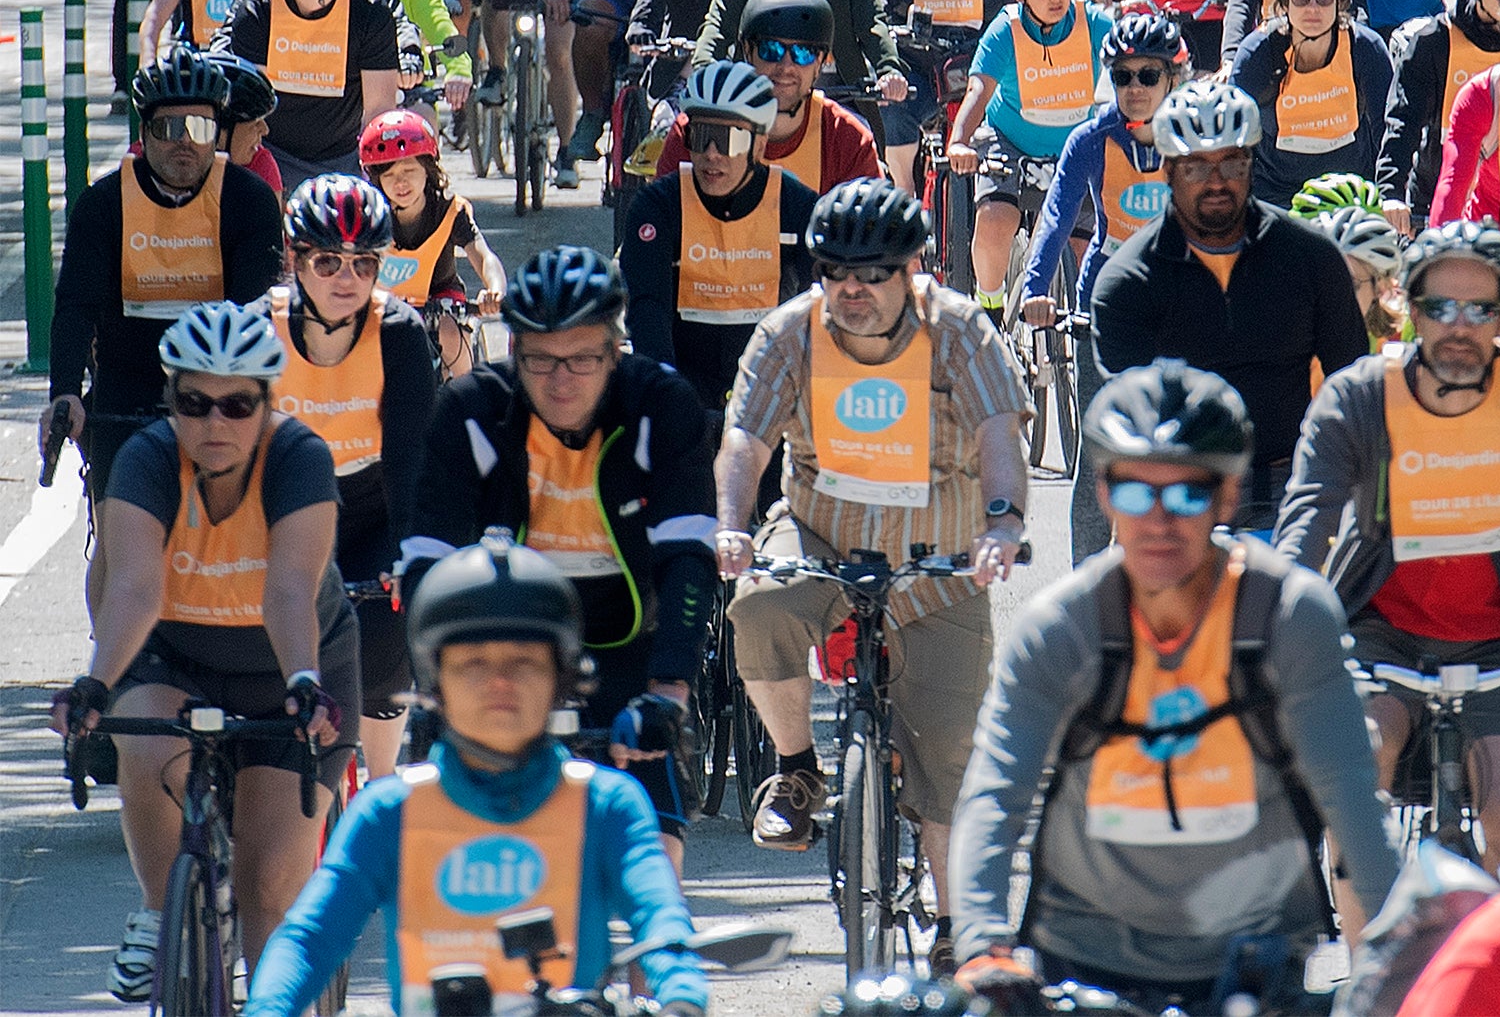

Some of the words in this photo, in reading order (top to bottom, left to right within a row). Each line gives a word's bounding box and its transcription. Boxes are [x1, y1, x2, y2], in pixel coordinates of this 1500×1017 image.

[290, 41, 342, 56] Desjardins
[277, 70, 301, 80] TOUR
[1039, 61, 1089, 78] Desjardins
[1032, 94, 1054, 106] TOUR
[1055, 93, 1068, 102] DE
[1298, 85, 1349, 106] Desjardins
[1125, 184, 1169, 212] lait
[150, 235, 214, 252] Desjardins
[709, 246, 773, 263] Desjardins
[383, 262, 417, 281] ait
[693, 281, 723, 294] TOUR
[723, 282, 740, 294] DE
[741, 281, 766, 294] L'ÎLE
[303, 396, 378, 415] Desjardins
[842, 387, 905, 420] lait
[828, 438, 863, 451] TOUR
[1410, 496, 1451, 510] TOUR
[450, 847, 538, 897] lait
